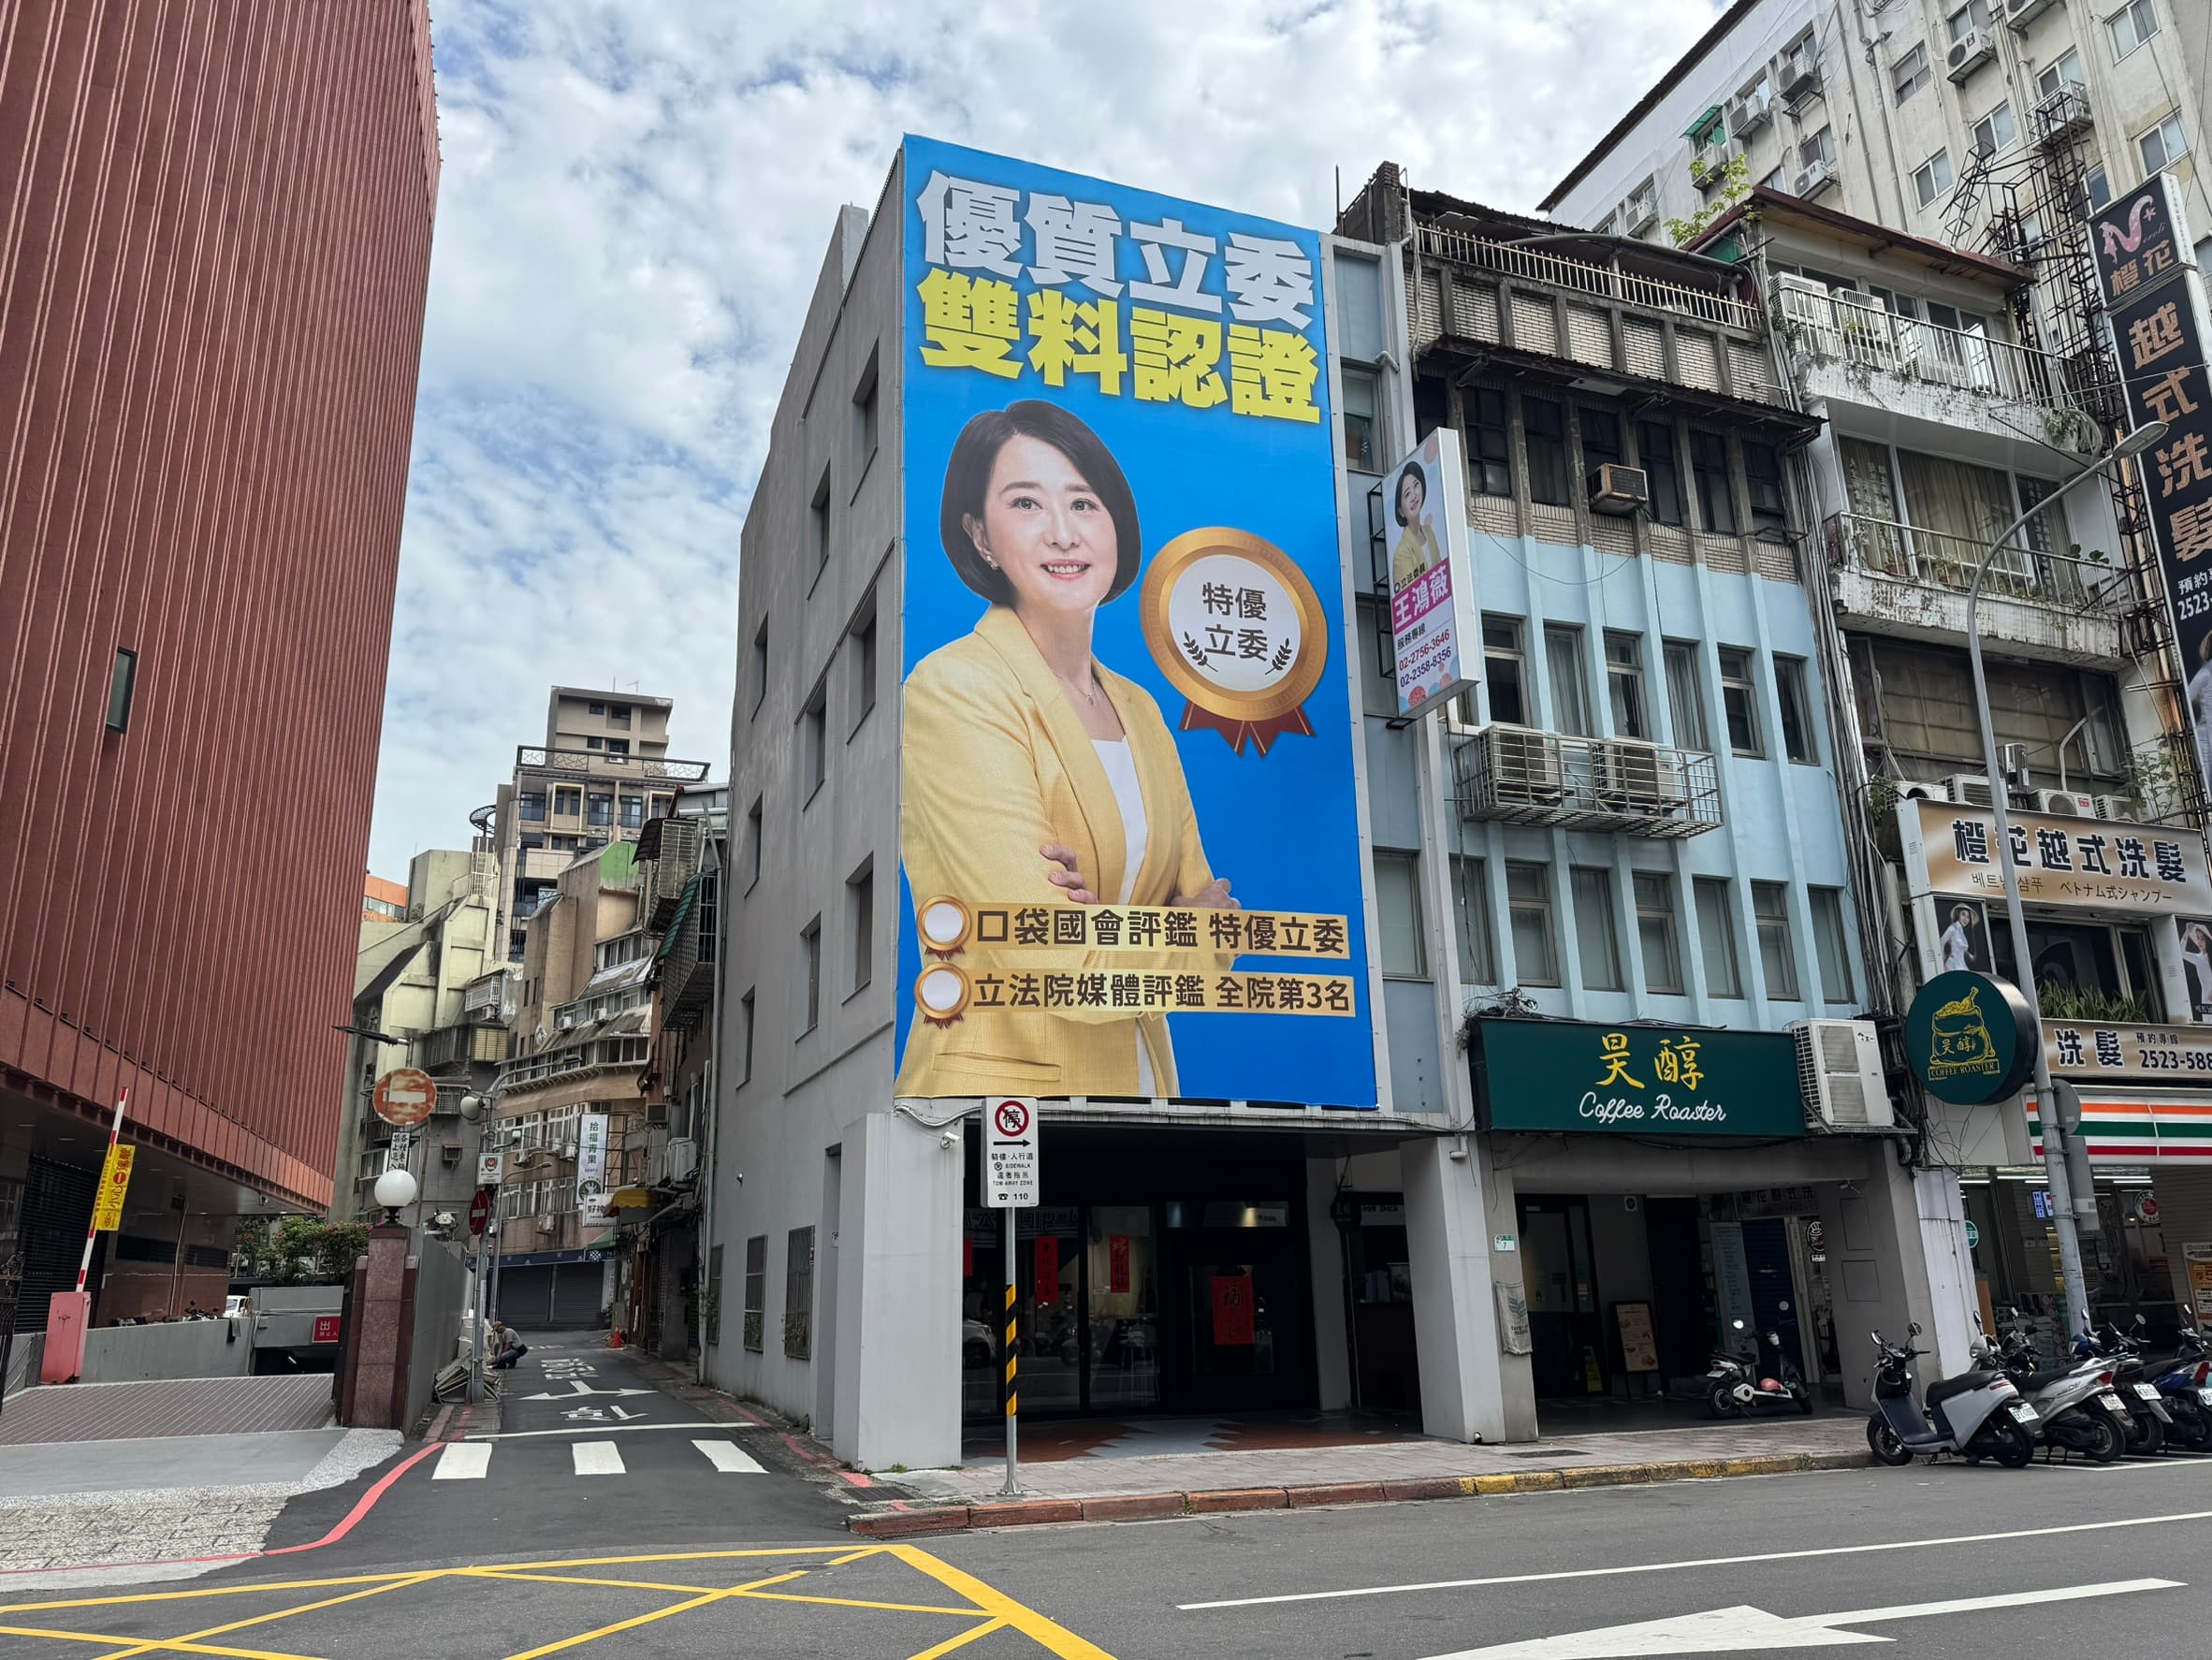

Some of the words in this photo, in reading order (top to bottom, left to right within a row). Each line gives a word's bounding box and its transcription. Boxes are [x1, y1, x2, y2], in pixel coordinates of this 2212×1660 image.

[916, 169, 1314, 329] 優質立委
[2110, 240, 2174, 297] 橙花
[916, 268, 1320, 424] 雙料認證
[1400, 562, 1426, 590] 立法委員
[2178, 568, 2212, 595] 預約
[1202, 582, 1267, 621] 特優
[1394, 564, 1448, 630] 王鴻薇
[1204, 624, 1268, 662] 立委
[1397, 622, 1426, 650] 服務專線
[1399, 629, 1450, 671] 02-2756-3646
[1400, 647, 1451, 688] 02-2358-8356
[977, 908, 1199, 948] 口袋國會評鑑
[1209, 913, 1346, 954] 特優立委
[973, 973, 1205, 1008] 立法院媒體評鑑
[1215, 976, 1349, 1012] 全院第3名
[2055, 1029, 2123, 1067] 洗髮
[2136, 1032, 2179, 1045] 預約專線
[1930, 1065, 1957, 1077] COFFEE
[1960, 1062, 1995, 1075] ROASTER
[1579, 1091, 1645, 1124] Coffee
[1651, 1093, 1726, 1122] Roaster
